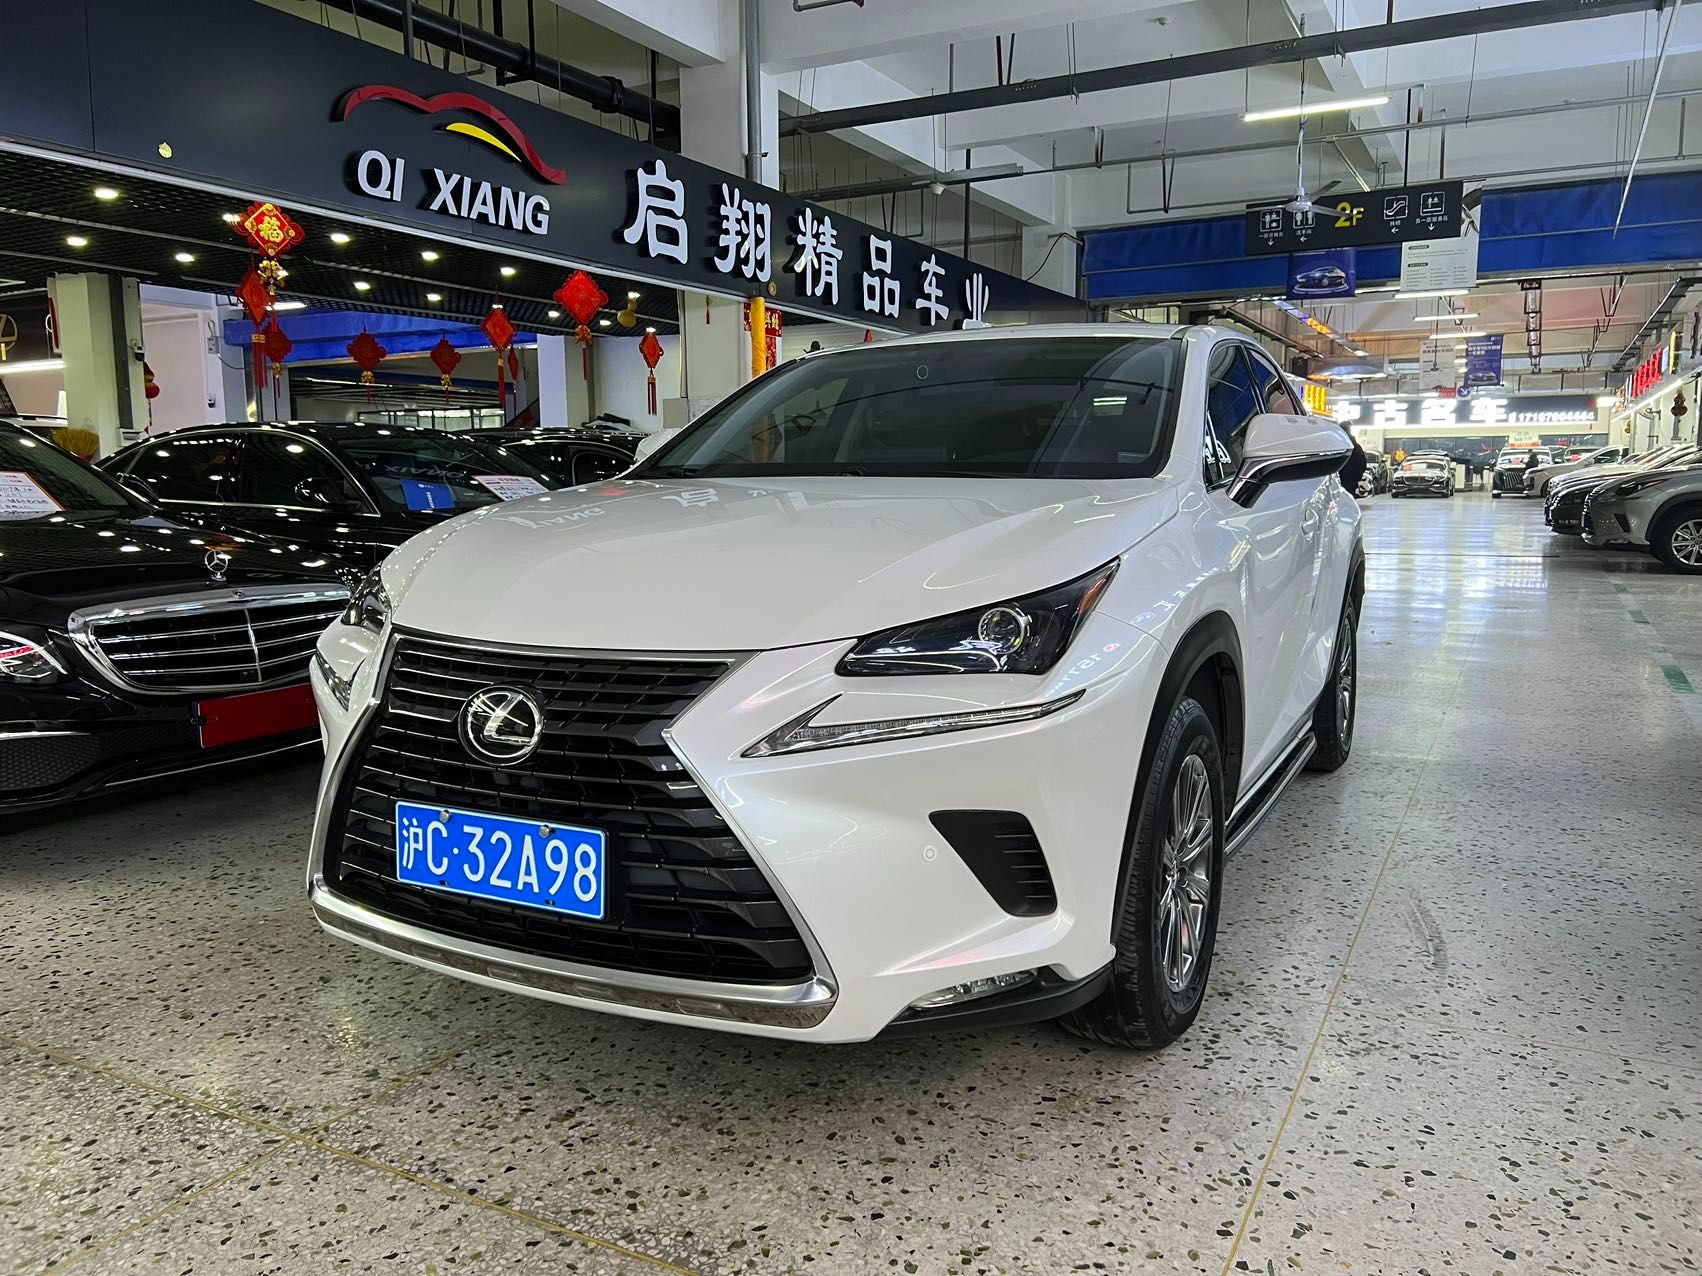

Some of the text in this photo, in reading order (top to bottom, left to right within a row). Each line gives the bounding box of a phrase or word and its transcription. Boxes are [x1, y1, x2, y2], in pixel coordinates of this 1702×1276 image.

[357, 150, 550, 235] QI XIANG
[1334, 201, 1364, 228] 2F
[257, 215, 285, 243] 福
[624, 158, 991, 329] 启翔精品车业
